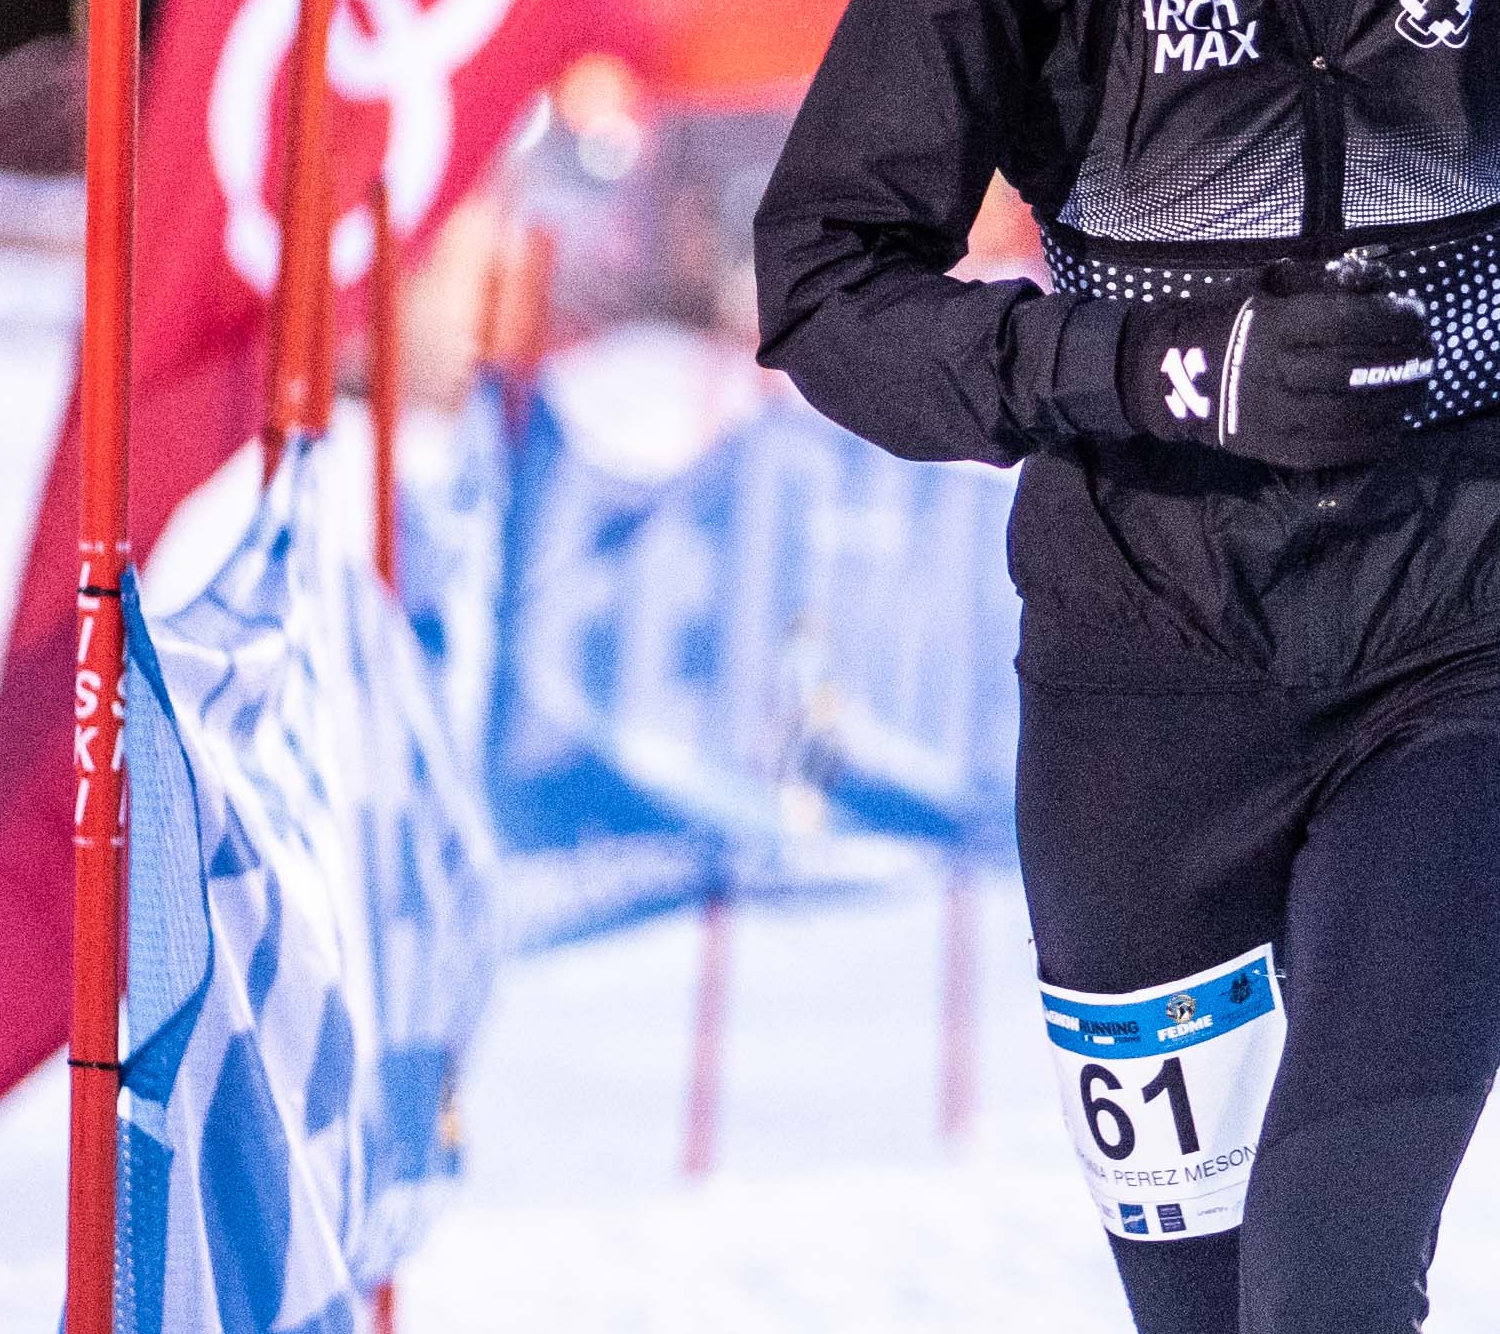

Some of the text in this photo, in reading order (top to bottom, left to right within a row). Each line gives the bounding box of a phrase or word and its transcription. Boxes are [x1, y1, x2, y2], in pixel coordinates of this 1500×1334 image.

[1153, 19, 1260, 74] MAX
[1156, 1014, 1214, 1042] FEDME
[1079, 1056, 1201, 1161] 61
[1113, 1169, 1180, 1187] PEREZ
